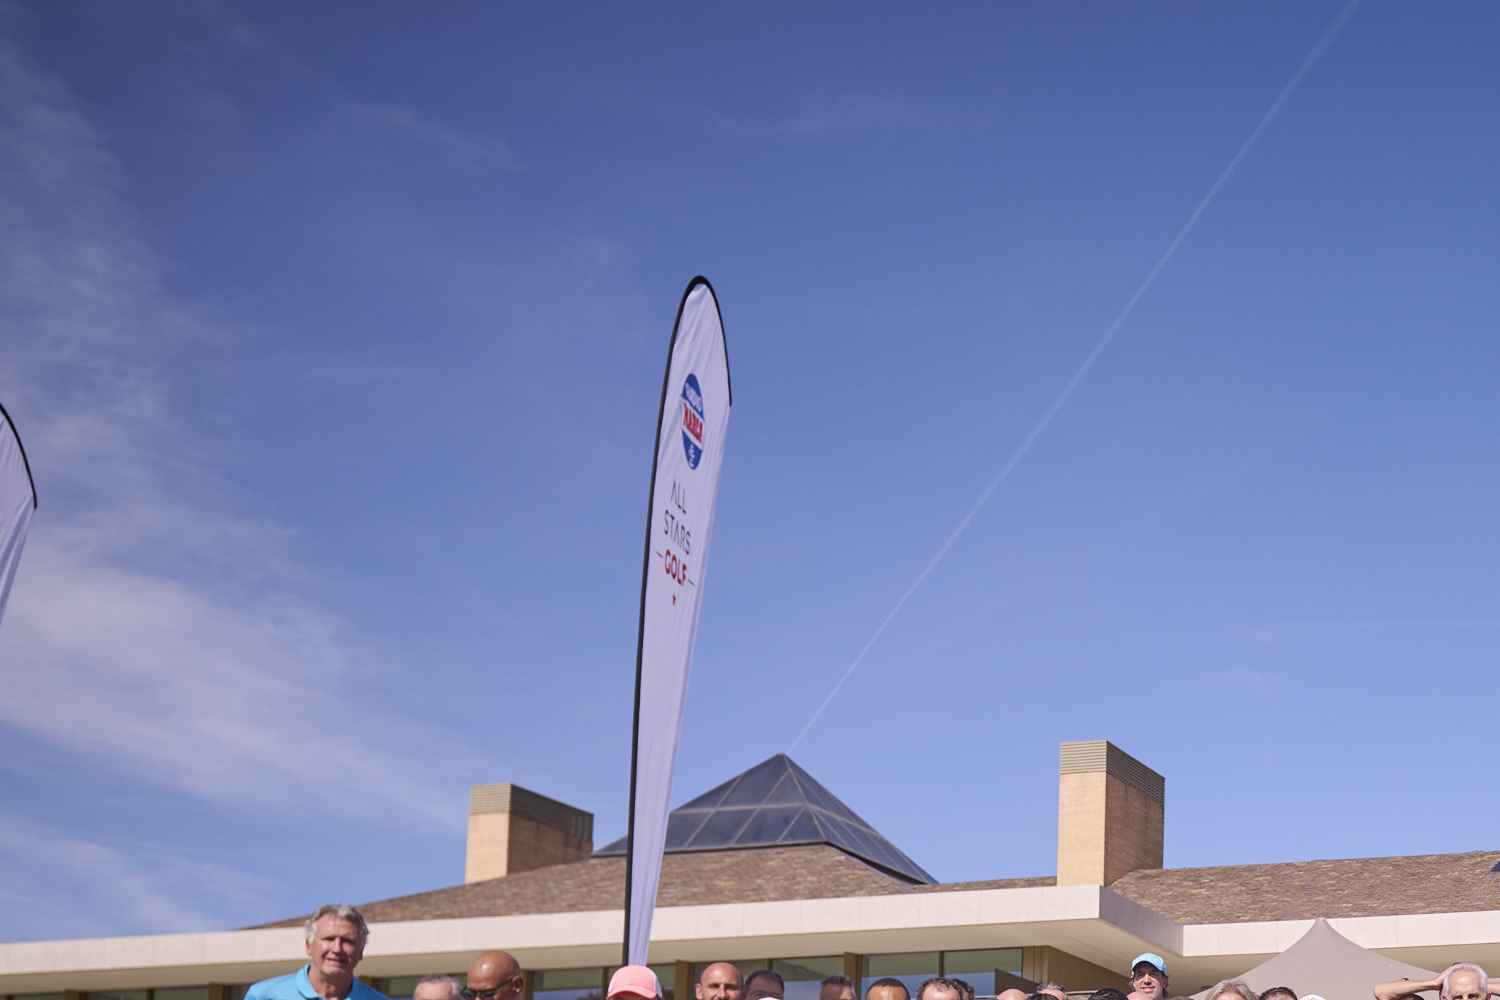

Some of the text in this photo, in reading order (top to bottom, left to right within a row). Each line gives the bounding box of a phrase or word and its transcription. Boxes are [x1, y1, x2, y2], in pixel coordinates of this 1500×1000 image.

[670, 480, 687, 514] ALL
[663, 509, 691, 555] STARS
[664, 549, 687, 587] GOLF
